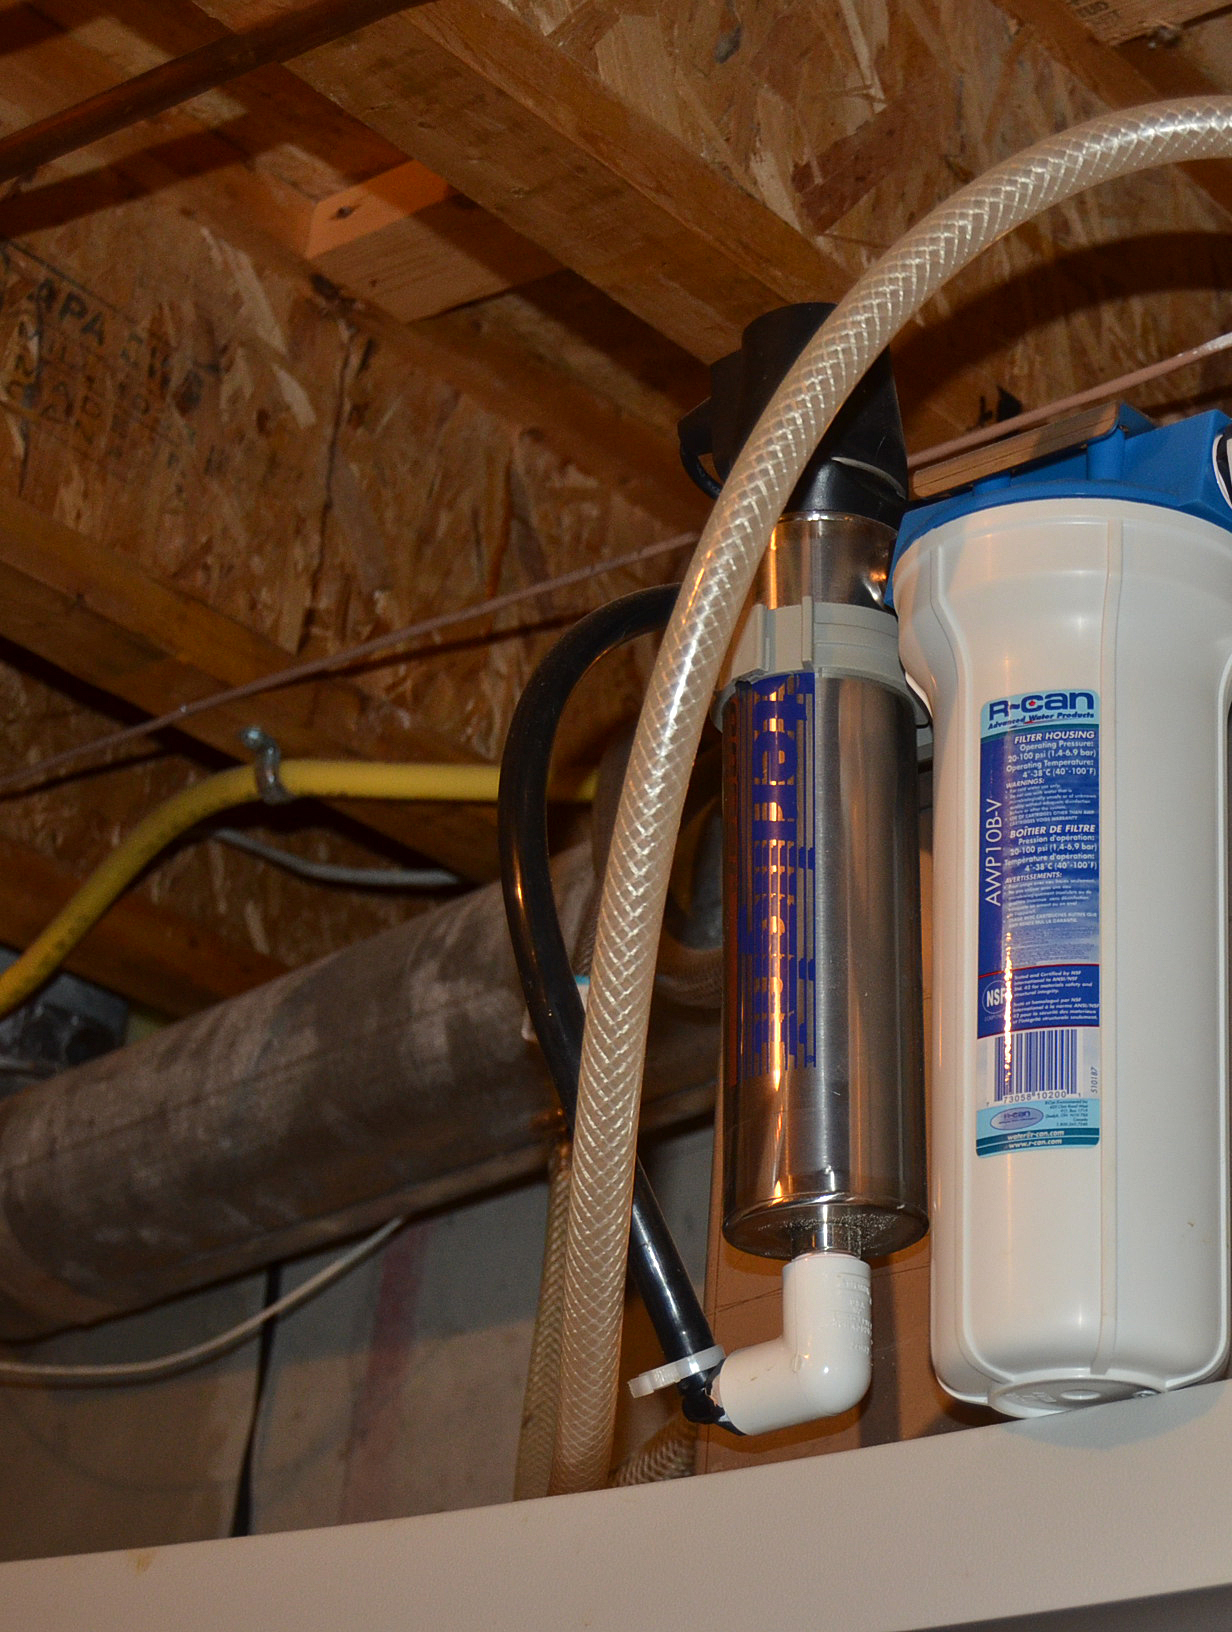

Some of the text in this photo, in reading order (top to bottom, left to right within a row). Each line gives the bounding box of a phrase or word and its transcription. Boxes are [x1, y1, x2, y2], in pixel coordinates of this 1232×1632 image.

[989, 692, 1094, 721] R-can
[988, 712, 1094, 730] Advanced Water Products
[1014, 731, 1095, 744] FILTER HOUSING
[1019, 740, 1094, 752] Operating Pressure:
[1008, 752, 1033, 763] 20-100
[1035, 751, 1046, 760] psi
[1080, 748, 1097, 757] bar)
[1006, 759, 1094, 774] Operating Temperature:
[1006, 778, 1045, 789] WARNINGS:
[1010, 824, 1096, 839] BOÎTIER DE FILTRE
[1018, 834, 1048, 845] Pression
[985, 798, 1002, 906] AWP10B-V
[1010, 846, 1035, 856] 20-100
[1037, 845, 1048, 853] psi
[1081, 842, 1097, 851] bar)
[1004, 854, 1048, 867] Température
[1005, 872, 1062, 884] AVERTISSEMENTS:
[986, 988, 1006, 1008] NSF
[1008, 1139, 1062, 1149] www.r-can.com
